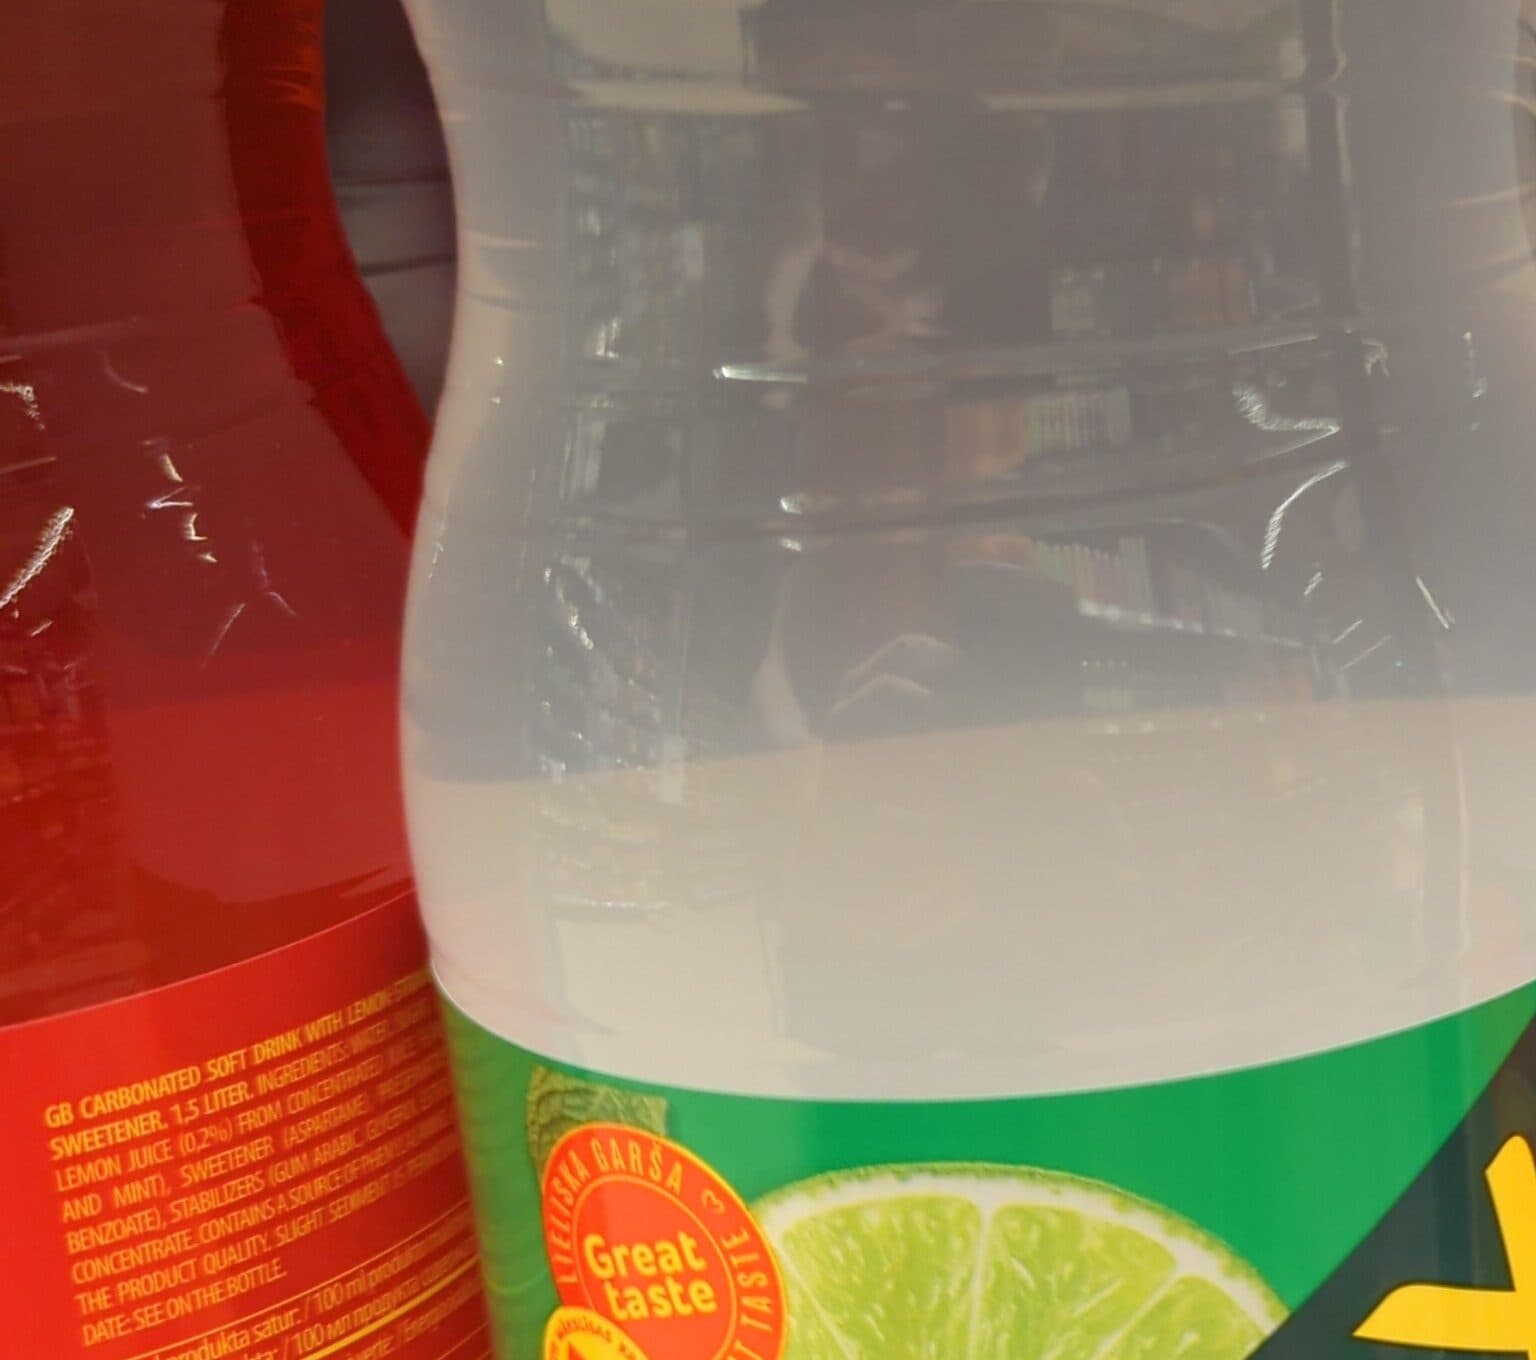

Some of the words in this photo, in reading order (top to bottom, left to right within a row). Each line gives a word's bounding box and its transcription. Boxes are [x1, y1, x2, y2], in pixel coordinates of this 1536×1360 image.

[43, 1101, 75, 1128] GB
[79, 1065, 201, 1120] CARBONATED
[206, 1048, 248, 1082] SOFT
[252, 1027, 303, 1065] DRINK
[304, 1010, 344, 1042] WITH
[50, 1110, 168, 1161] SWEETENER.
[55, 1154, 122, 1193] LEMON
[127, 1138, 175, 1173] JUICE
[238, 1099, 283, 1136] FROM
[62, 1192, 103, 1224] AND
[178, 1135, 275, 1189] SWEETENER
[168, 1170, 266, 1224] STABILIZERS
[199, 1197, 276, 1242] CONTAINS
[551, 1149, 590, 1285] LIELISKA
[591, 1137, 683, 1198] GARŠA
[583, 1229, 708, 1278] Great
[718, 1226, 773, 1332] TASTE
[74, 1285, 114, 1316] THE
[116, 1257, 198, 1305] PRODUCT
[132, 1302, 166, 1330] SEE
[165, 1293, 193, 1320] ON
[192, 1282, 227, 1310] THE
[313, 1281, 344, 1314] 100
[604, 1275, 718, 1321] taste
[292, 1321, 326, 1356] 100
